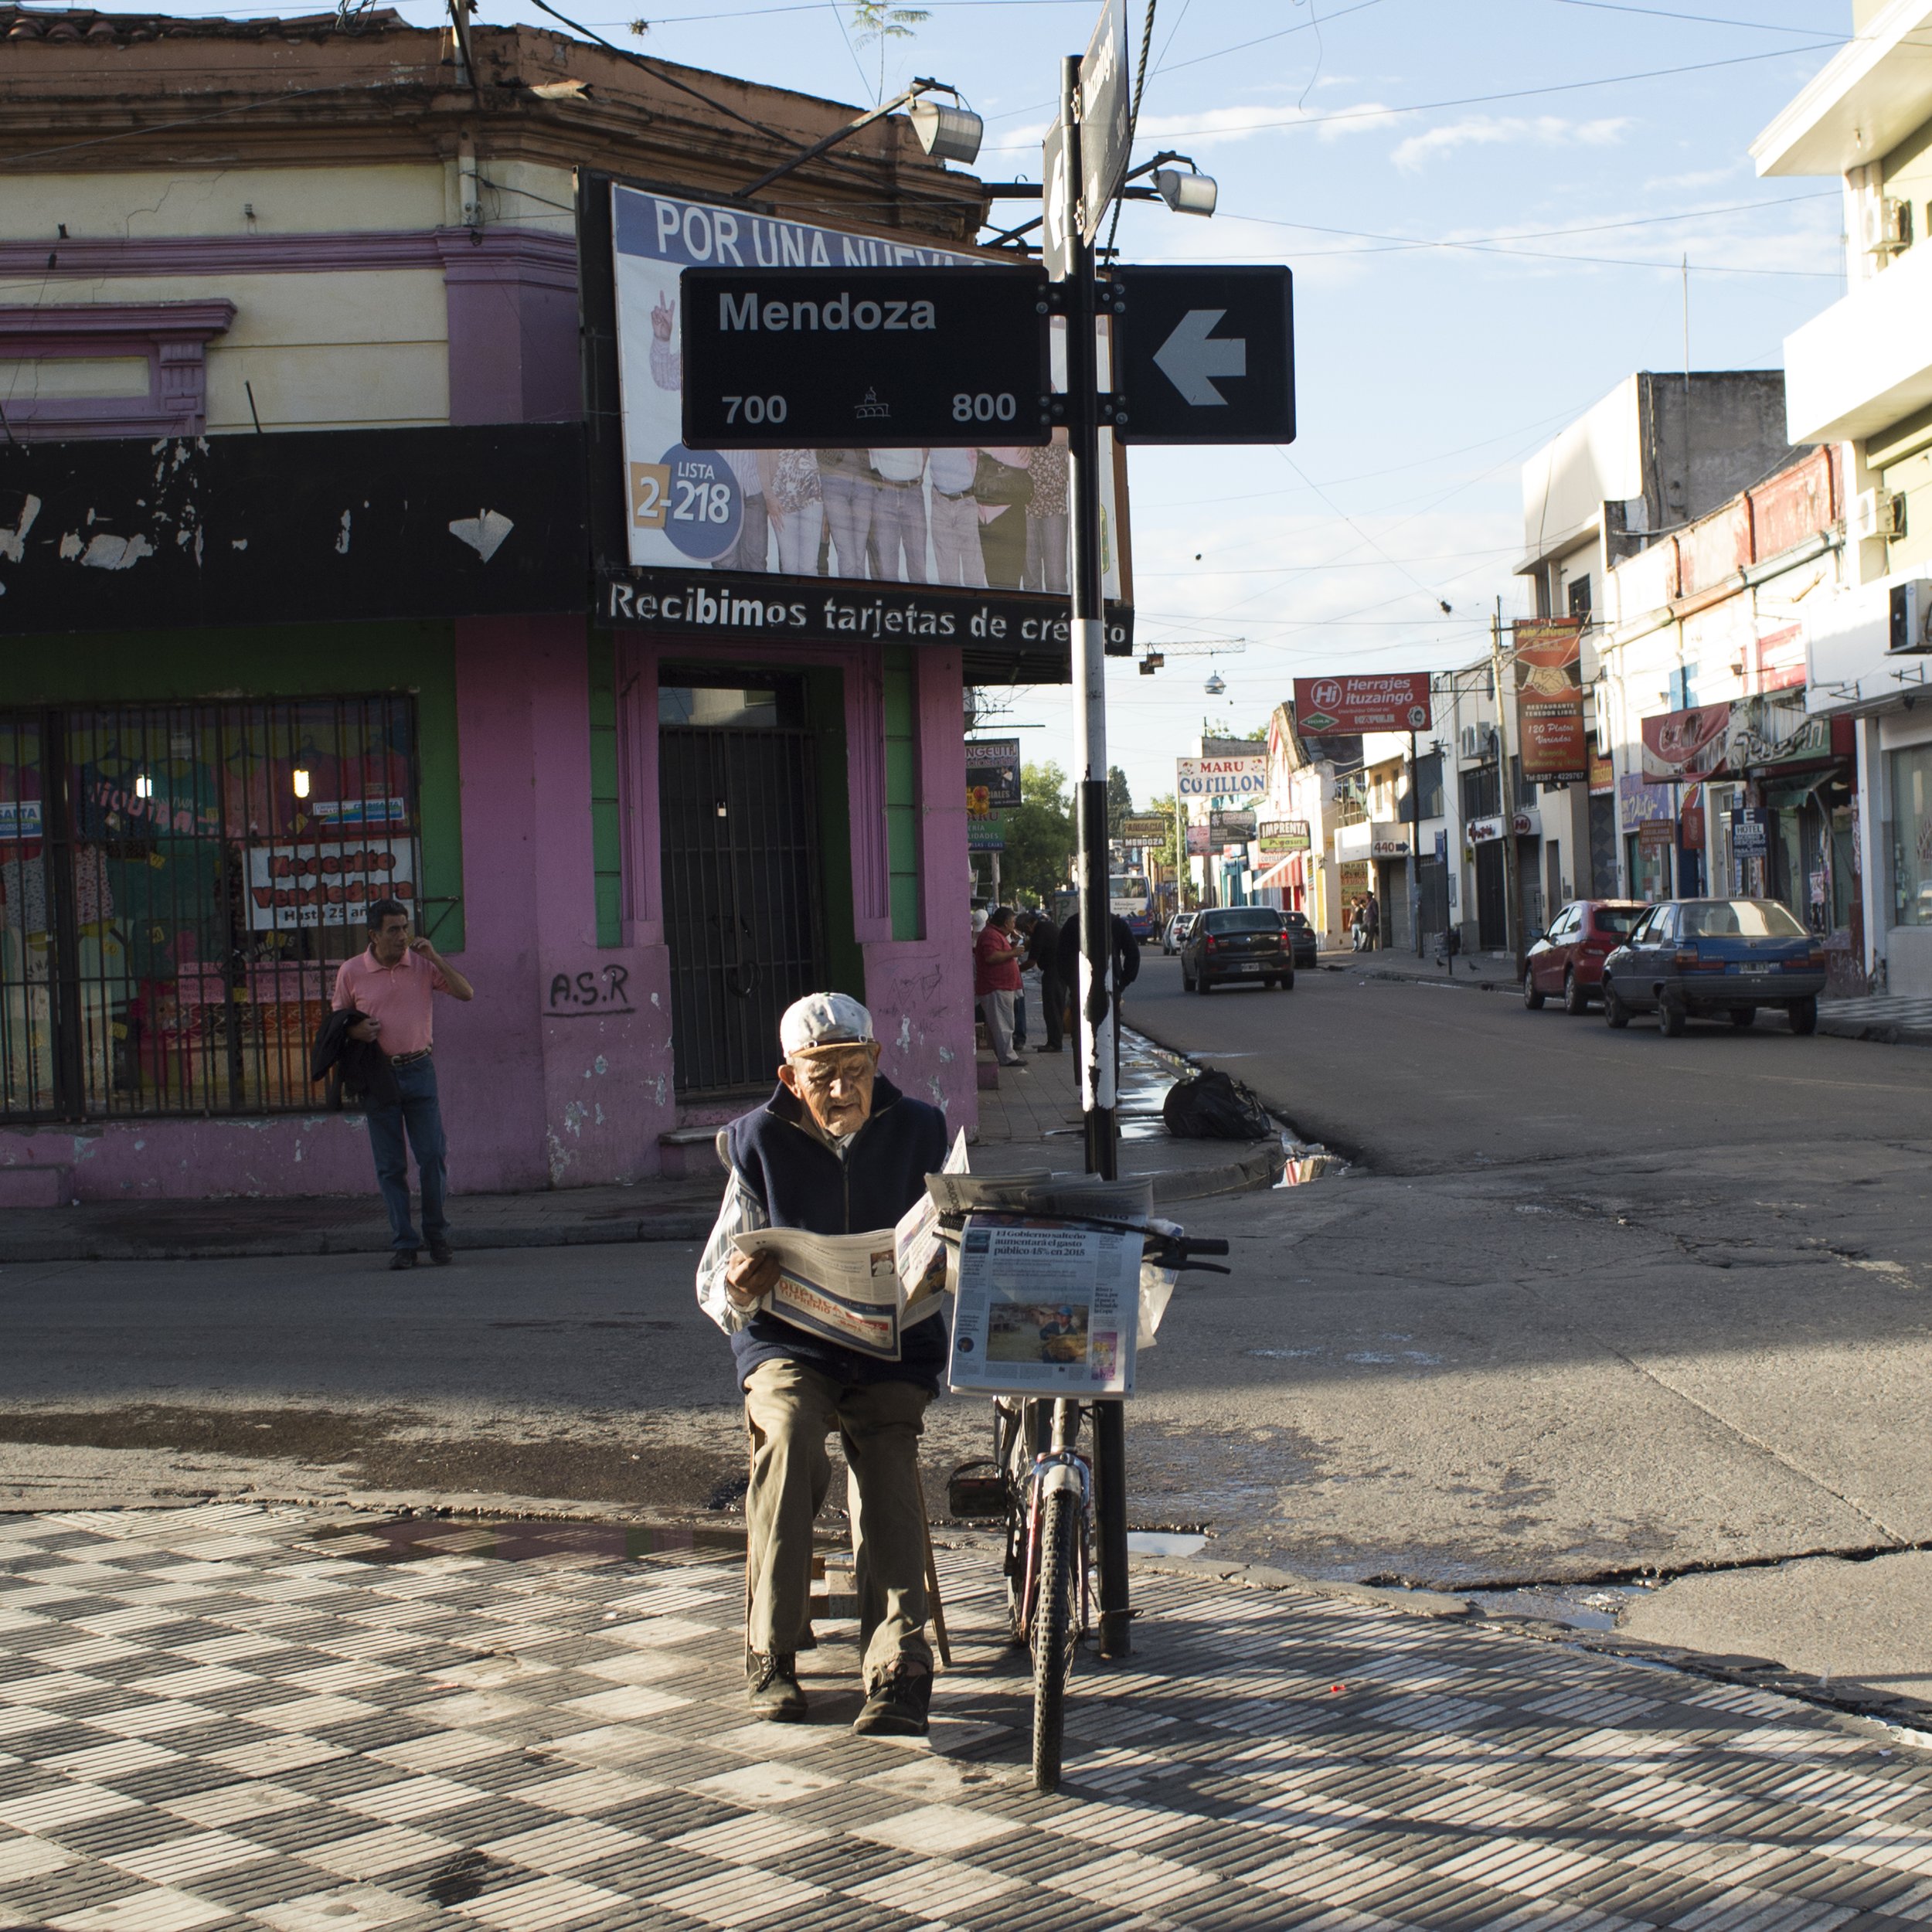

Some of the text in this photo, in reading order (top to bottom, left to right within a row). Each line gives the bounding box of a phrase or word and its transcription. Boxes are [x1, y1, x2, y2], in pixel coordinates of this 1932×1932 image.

[655, 199, 743, 267] POR
[753, 220, 830, 267] UNA
[719, 293, 936, 330] Mendoza
[722, 393, 1016, 423] 700 800
[678, 462, 715, 480] LISTA
[637, 477, 730, 524] 2-218
[611, 582, 1126, 645] Recibimos tarjetas de créo
[1347, 677, 1410, 692] Herrajes
[1316, 685, 1413, 705] Hi ituzaingó
[1528, 723, 1574, 734] 120 Platos
[1536, 734, 1572, 745] Variados
[966, 747, 1015, 757] NGELITA
[1200, 761, 1244, 772] MARU
[1179, 775, 1265, 794] COTILLON
[991, 790, 1010, 798] IALES
[967, 811, 998, 821] ARU
[1743, 809, 1754, 823] E
[1262, 822, 1308, 838] IMPRENTA
[1125, 838, 1164, 846] MENDOZA
[1375, 842, 1395, 852] 440
[268, 849, 396, 878] Necesito
[252, 881, 413, 908] Vendedora
[284, 908, 324, 920] Hst
[351, 906, 367, 917] añ
[1006, 1230, 1051, 1238] Gobierno
[995, 1237, 1046, 1246] aumentará
[1056, 1239, 1082, 1247] gasto
[994, 1246, 1029, 1256] público
[794, 1294, 831, 1314] PREMIO
